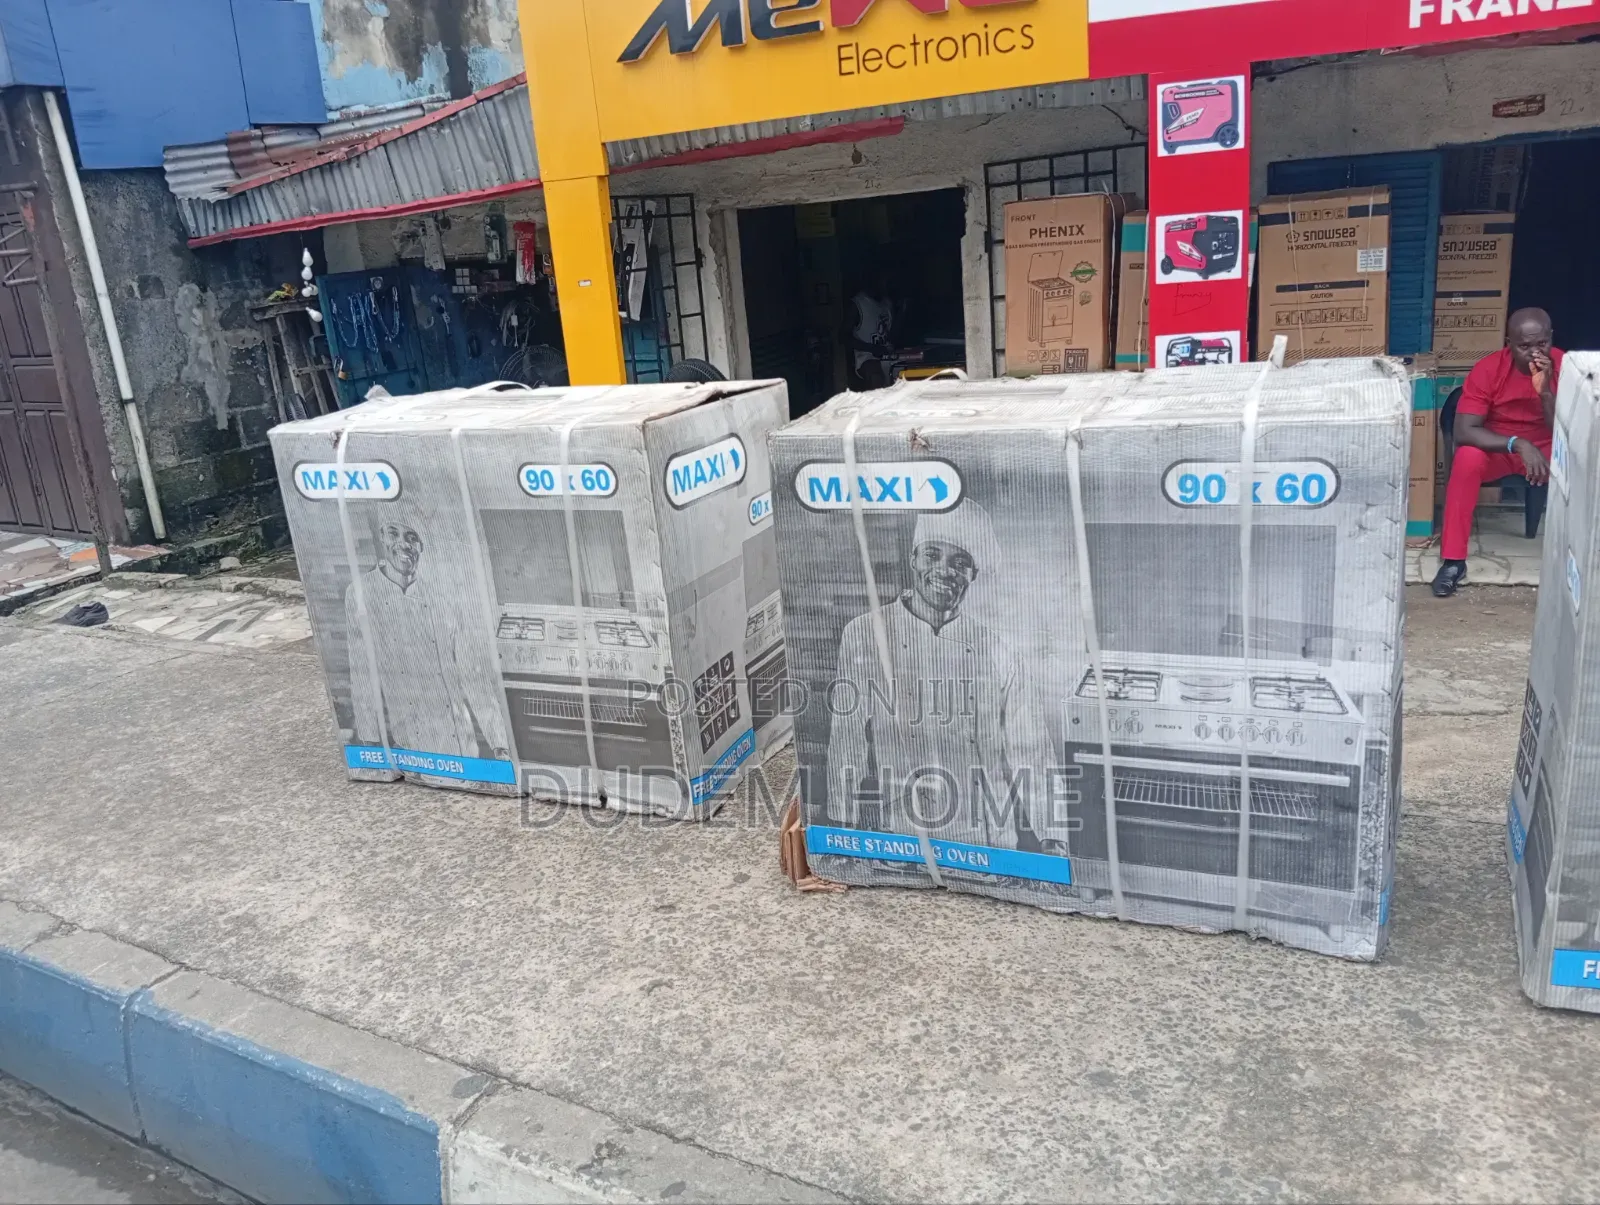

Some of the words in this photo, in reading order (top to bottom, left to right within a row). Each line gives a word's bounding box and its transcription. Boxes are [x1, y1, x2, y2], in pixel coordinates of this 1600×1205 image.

[1408, 0, 1594, 29] FRAN
[837, 22, 1035, 77] Electronics
[1010, 214, 1036, 223] FRONT
[1029, 224, 1085, 239] PHENIX
[1287, 242, 1327, 252] HORIZONTAL
[1328, 240, 1358, 249] FREEZER
[301, 471, 370, 490] MAXI
[525, 469, 555, 491] 90
[581, 469, 611, 491] 60
[672, 452, 726, 496] MAXI
[807, 476, 914, 503] MAXI
[1177, 473, 1227, 504] 90
[1275, 473, 1327, 504] 60
[751, 500, 763, 520] 90
[359, 750, 385, 764] FREE
[388, 754, 435, 770] TANDING
[437, 758, 464, 774] OVEN
[825, 833, 861, 852] FREE
[865, 838, 943, 861] STANDIG
[946, 848, 990, 867] OVEN
